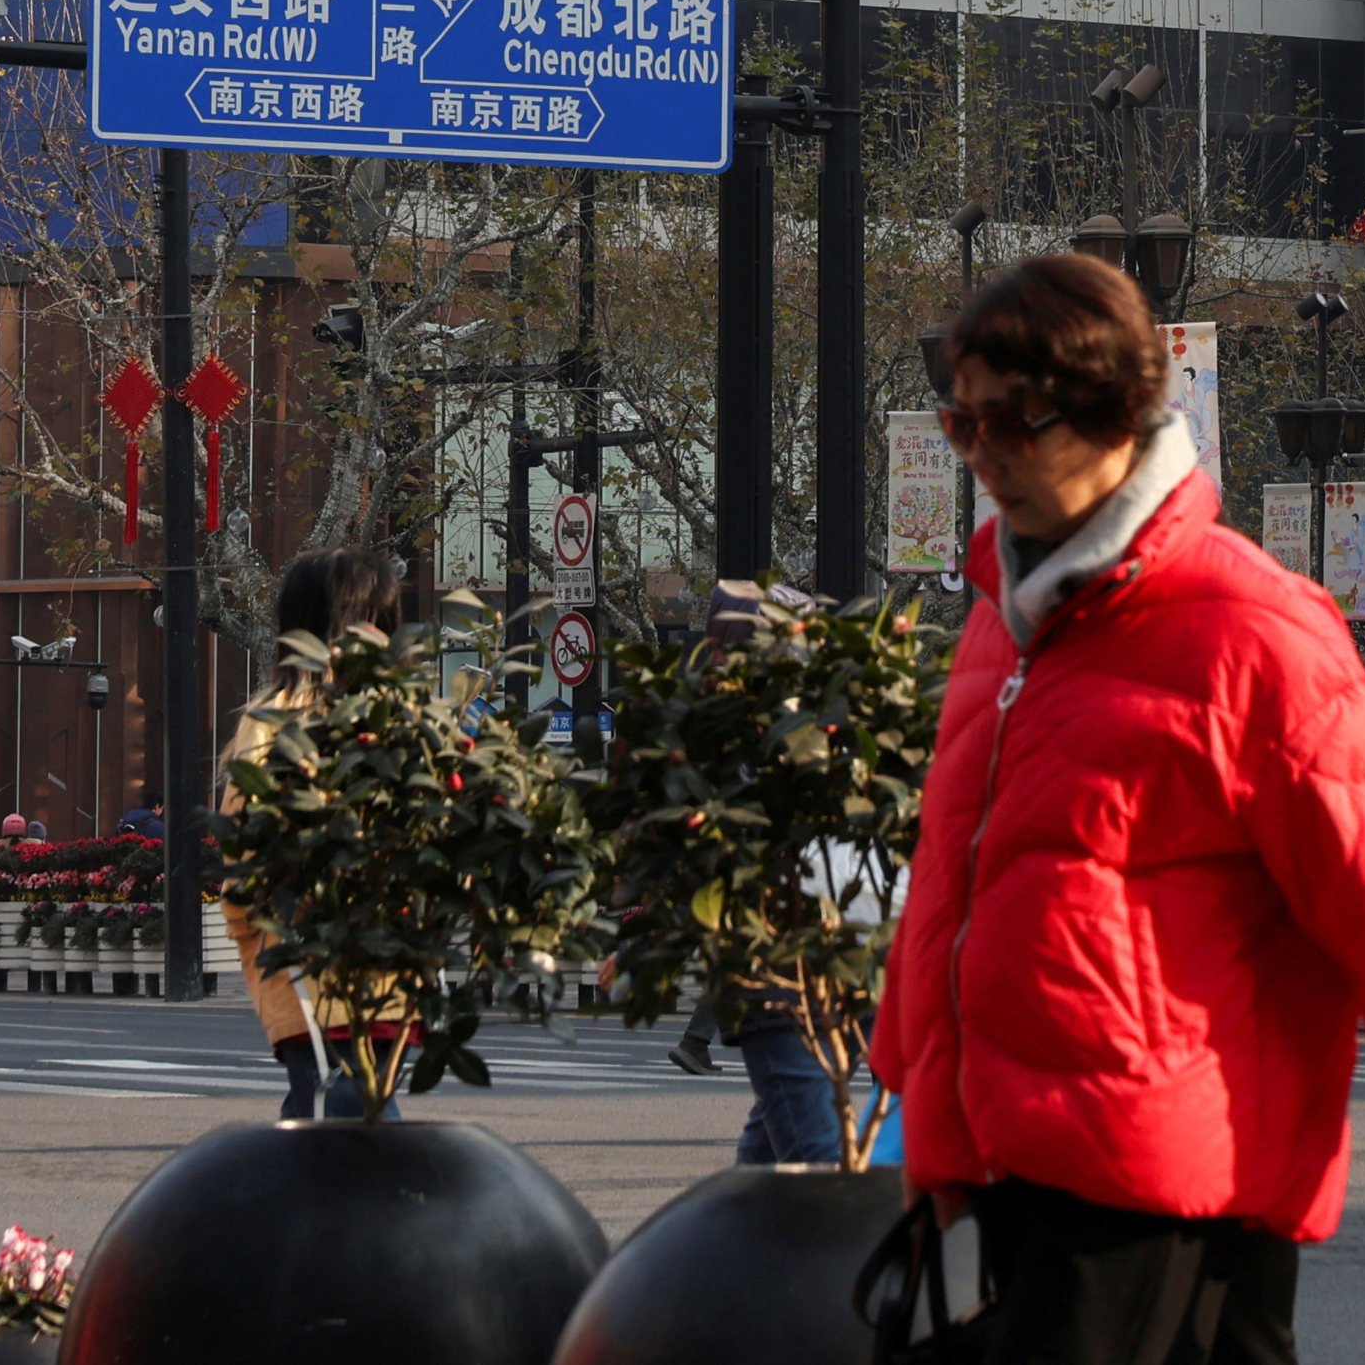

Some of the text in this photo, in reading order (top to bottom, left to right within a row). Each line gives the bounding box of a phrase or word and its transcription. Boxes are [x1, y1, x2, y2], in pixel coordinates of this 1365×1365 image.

[223, 25, 317, 65] Rd.(W)
[503, 39, 720, 87] Chengdu Rd.(N)
[208, 77, 365, 124] 南京西路
[431, 88, 584, 136] 南京西路
